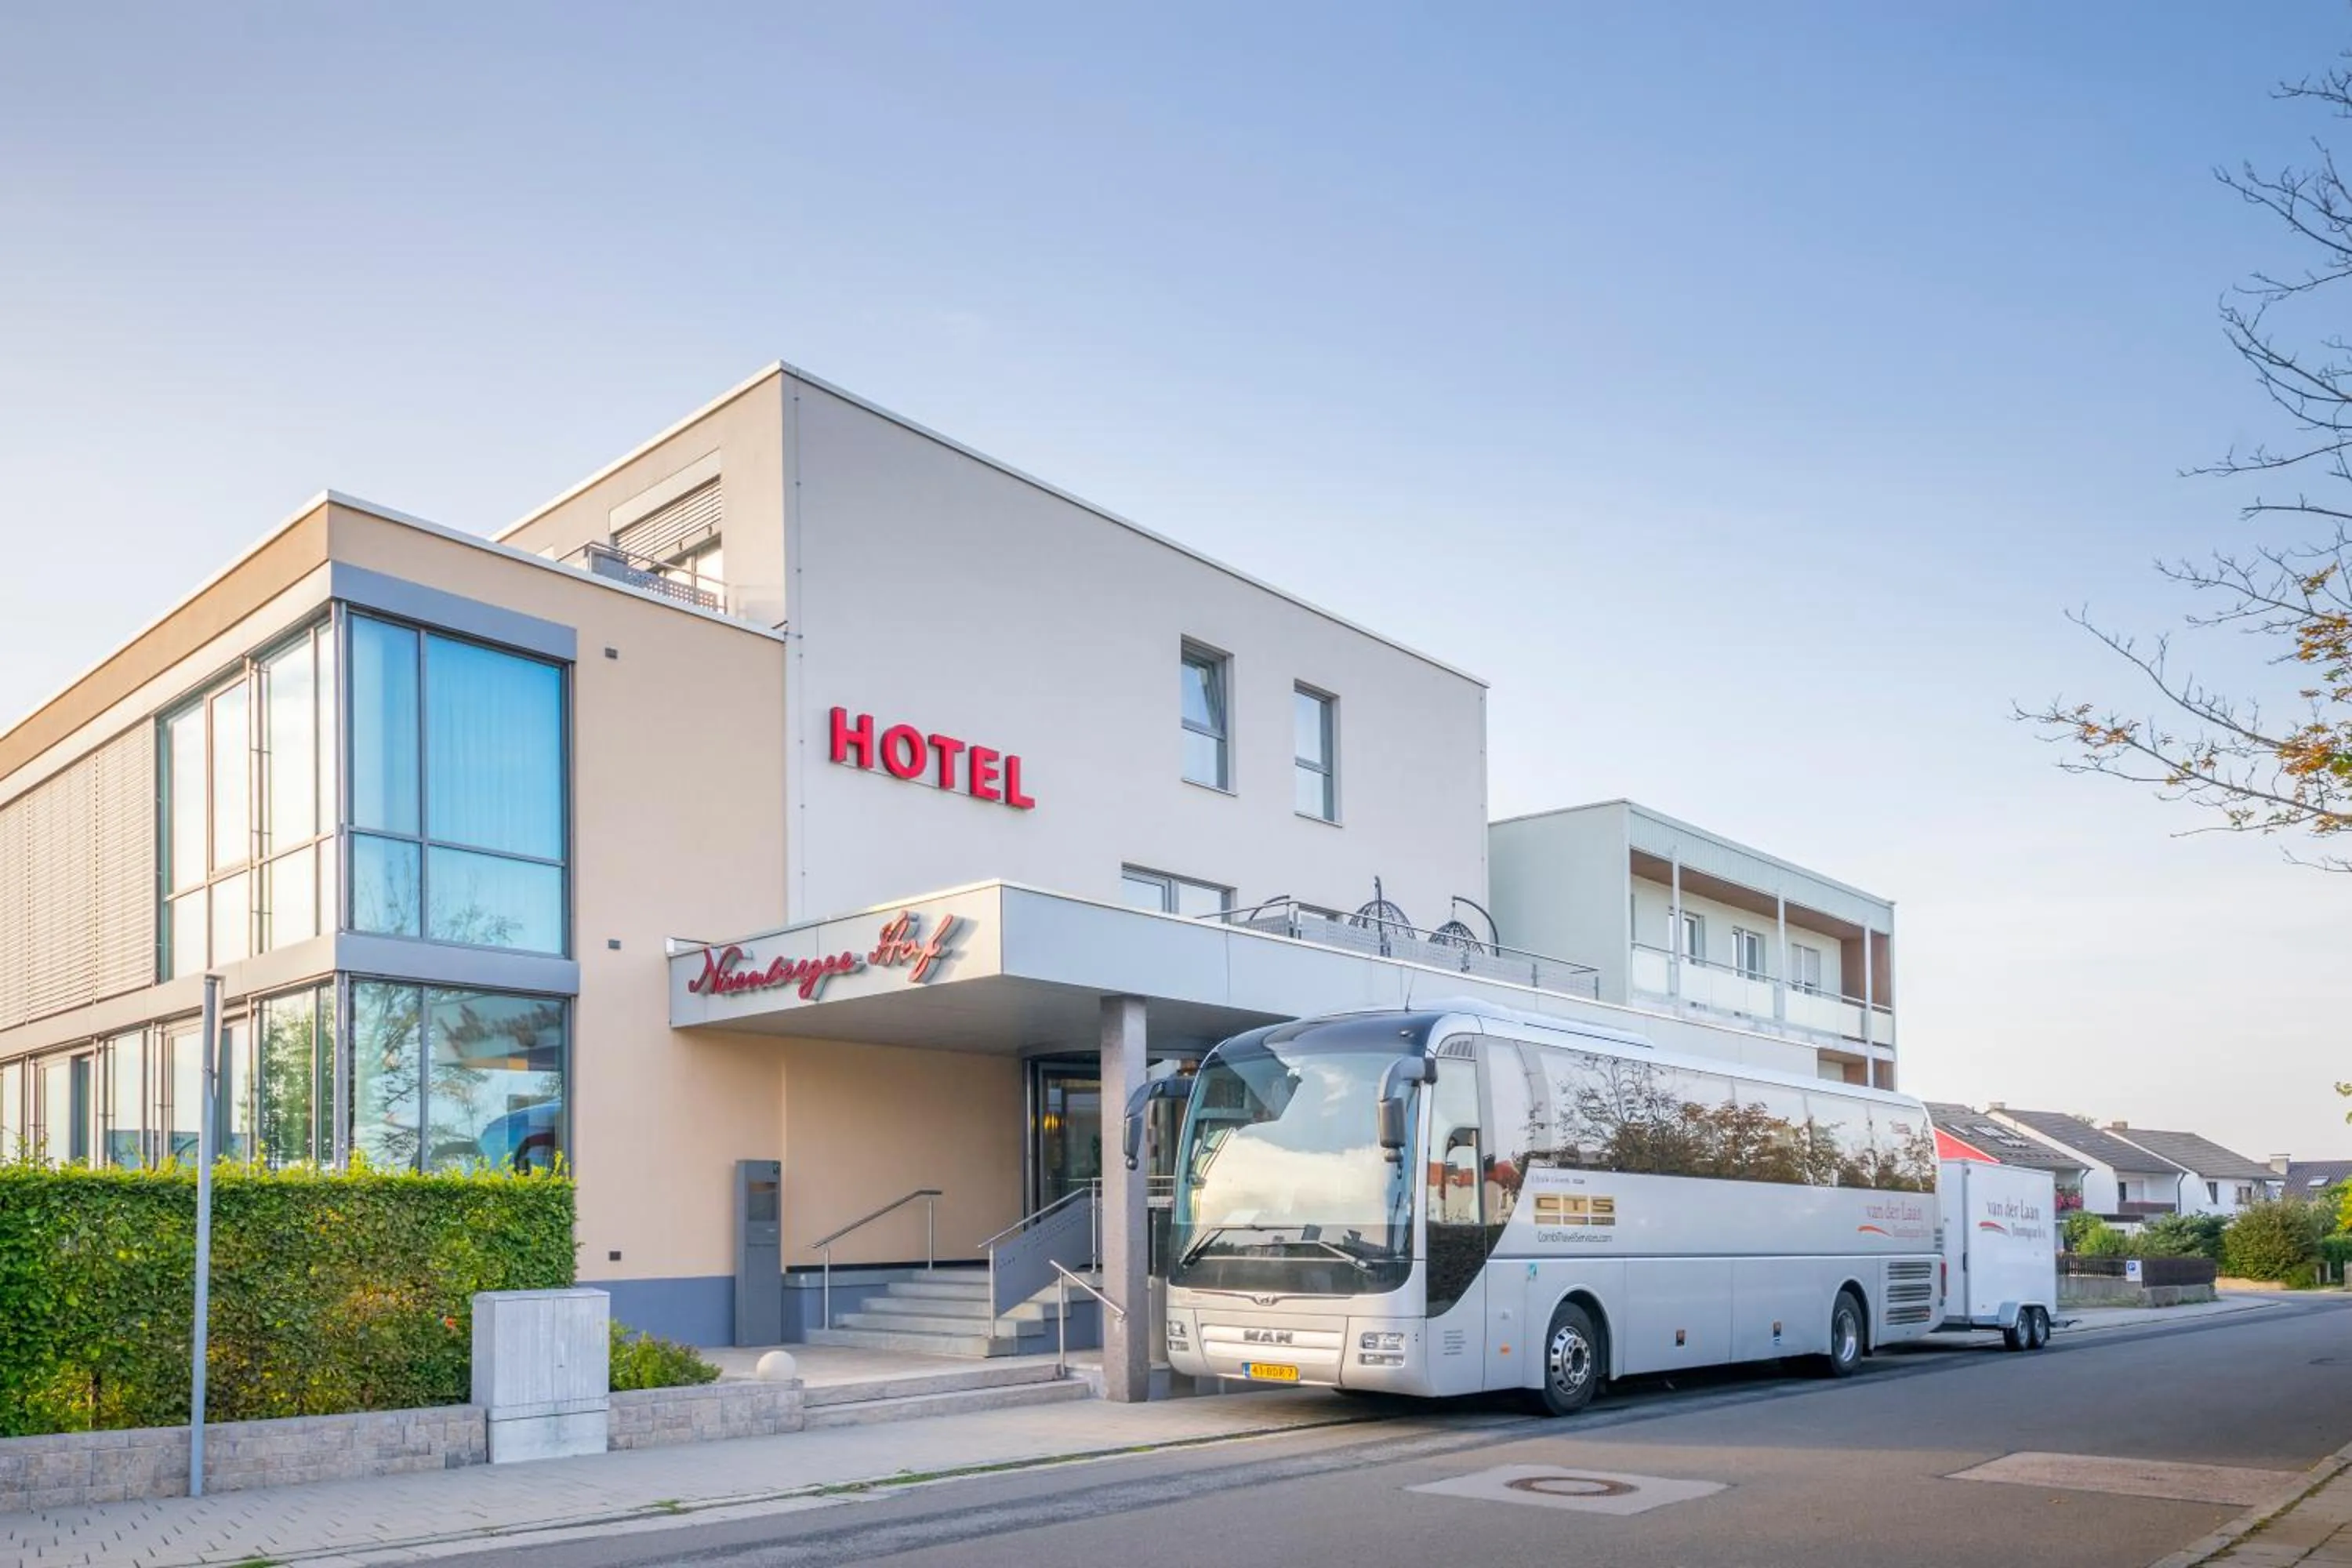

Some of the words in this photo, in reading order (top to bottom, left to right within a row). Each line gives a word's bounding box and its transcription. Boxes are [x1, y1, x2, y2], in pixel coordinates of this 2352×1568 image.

[830, 706, 1035, 809] HOTEL
[868, 909, 953, 982] Hof
[1536, 1196, 1614, 1213] CTS
[1986, 1201, 2003, 1218] van
[2020, 1198, 2040, 1221] Laan
[1243, 1329, 1292, 1344] MAN
